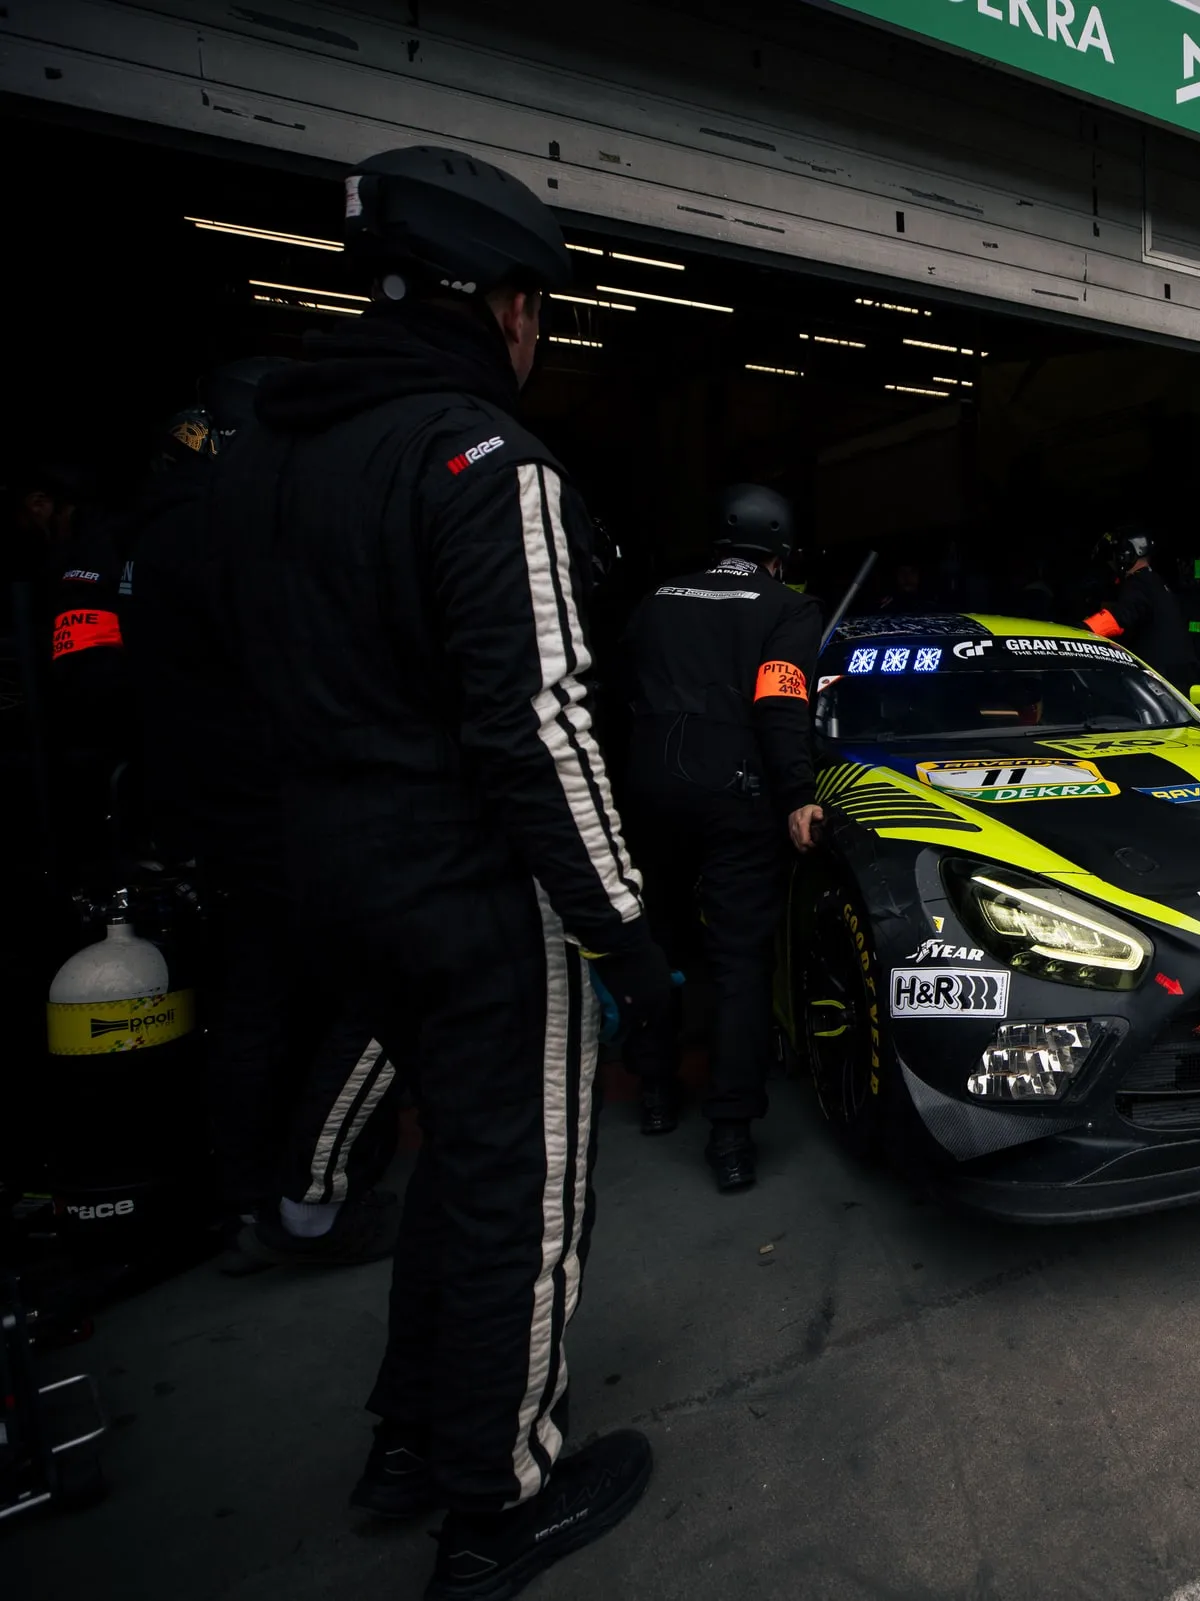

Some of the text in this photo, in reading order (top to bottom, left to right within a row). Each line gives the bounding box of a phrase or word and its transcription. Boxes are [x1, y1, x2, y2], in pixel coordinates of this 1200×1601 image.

[465, 436, 505, 465] RRS
[1005, 639, 1059, 651] GRAN
[1060, 641, 1134, 662] TURISMO
[1059, 651, 1094, 659] DRIVING
[778, 684, 801, 695] 416
[981, 768, 1028, 787] 11
[994, 784, 1106, 801] DEKRA
[900, 976, 960, 1010] H&R
[130, 1008, 177, 1032] paoli
[66, 1199, 135, 1220] race
